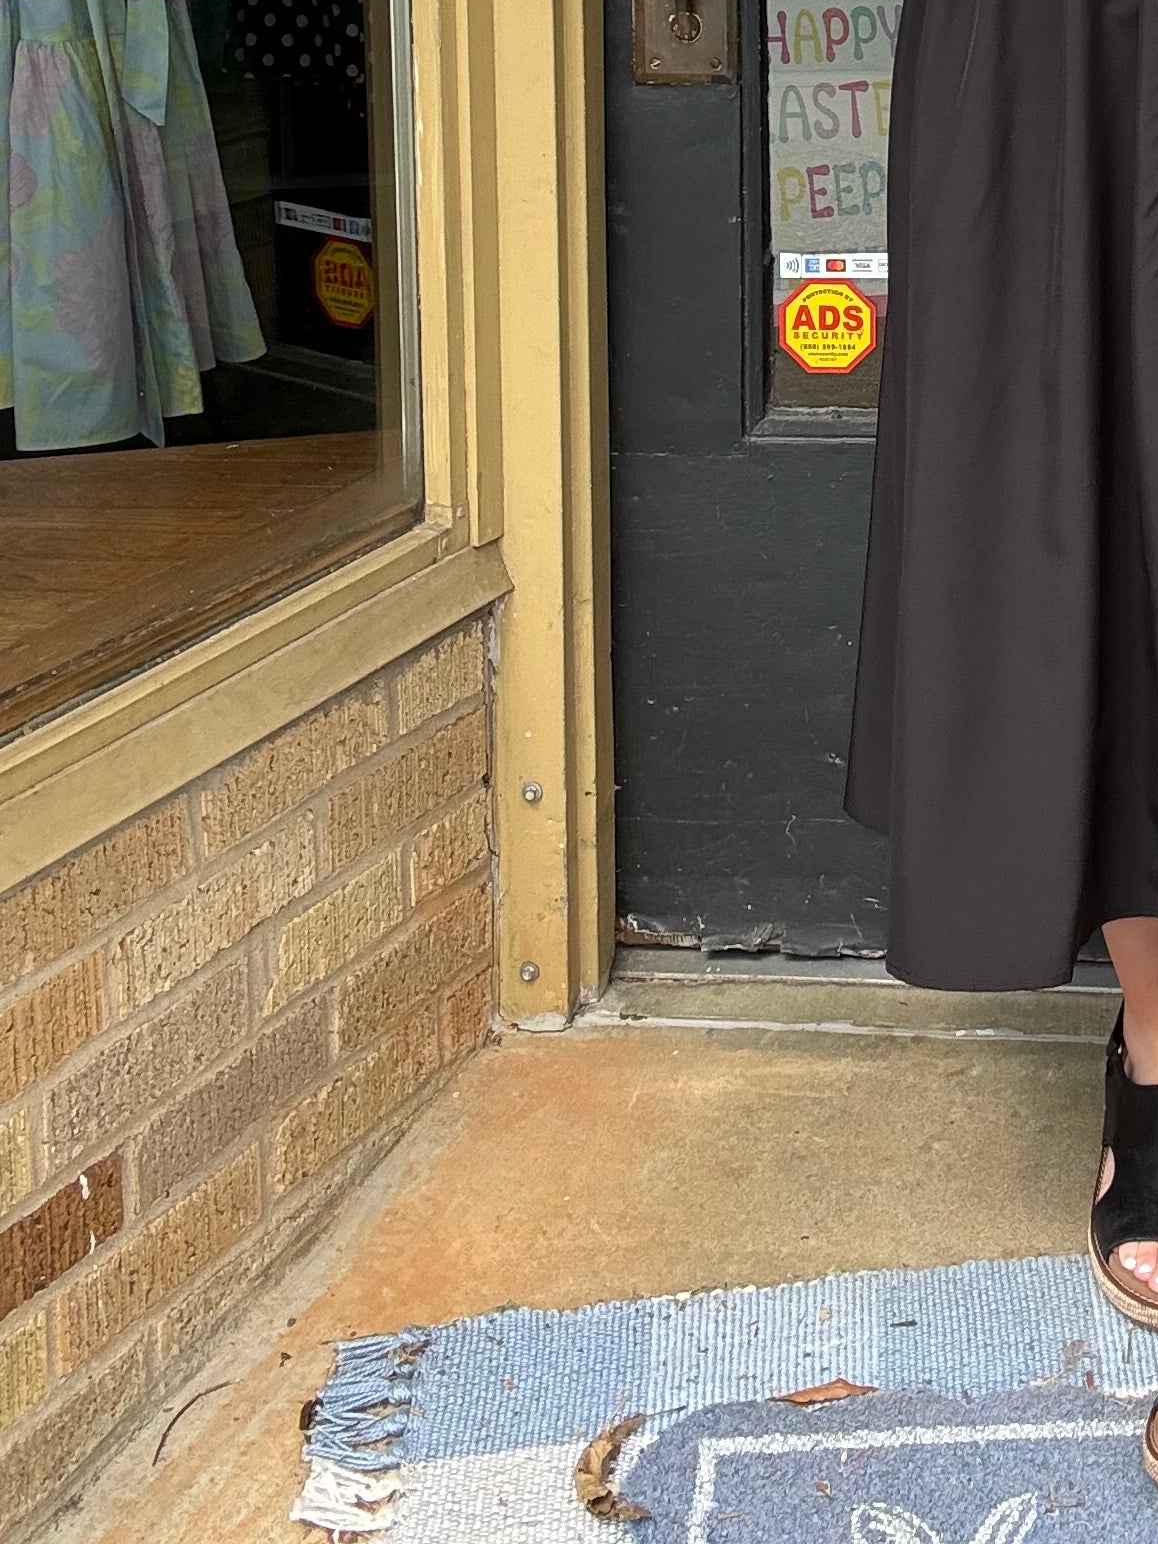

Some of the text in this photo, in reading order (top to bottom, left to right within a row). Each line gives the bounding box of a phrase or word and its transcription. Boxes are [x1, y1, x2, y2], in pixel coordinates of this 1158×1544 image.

[766, 5, 903, 65] HAPPY
[772, 79, 892, 143] ASTE
[791, 304, 864, 331] ADS
[793, 332, 863, 340] SECURITY
